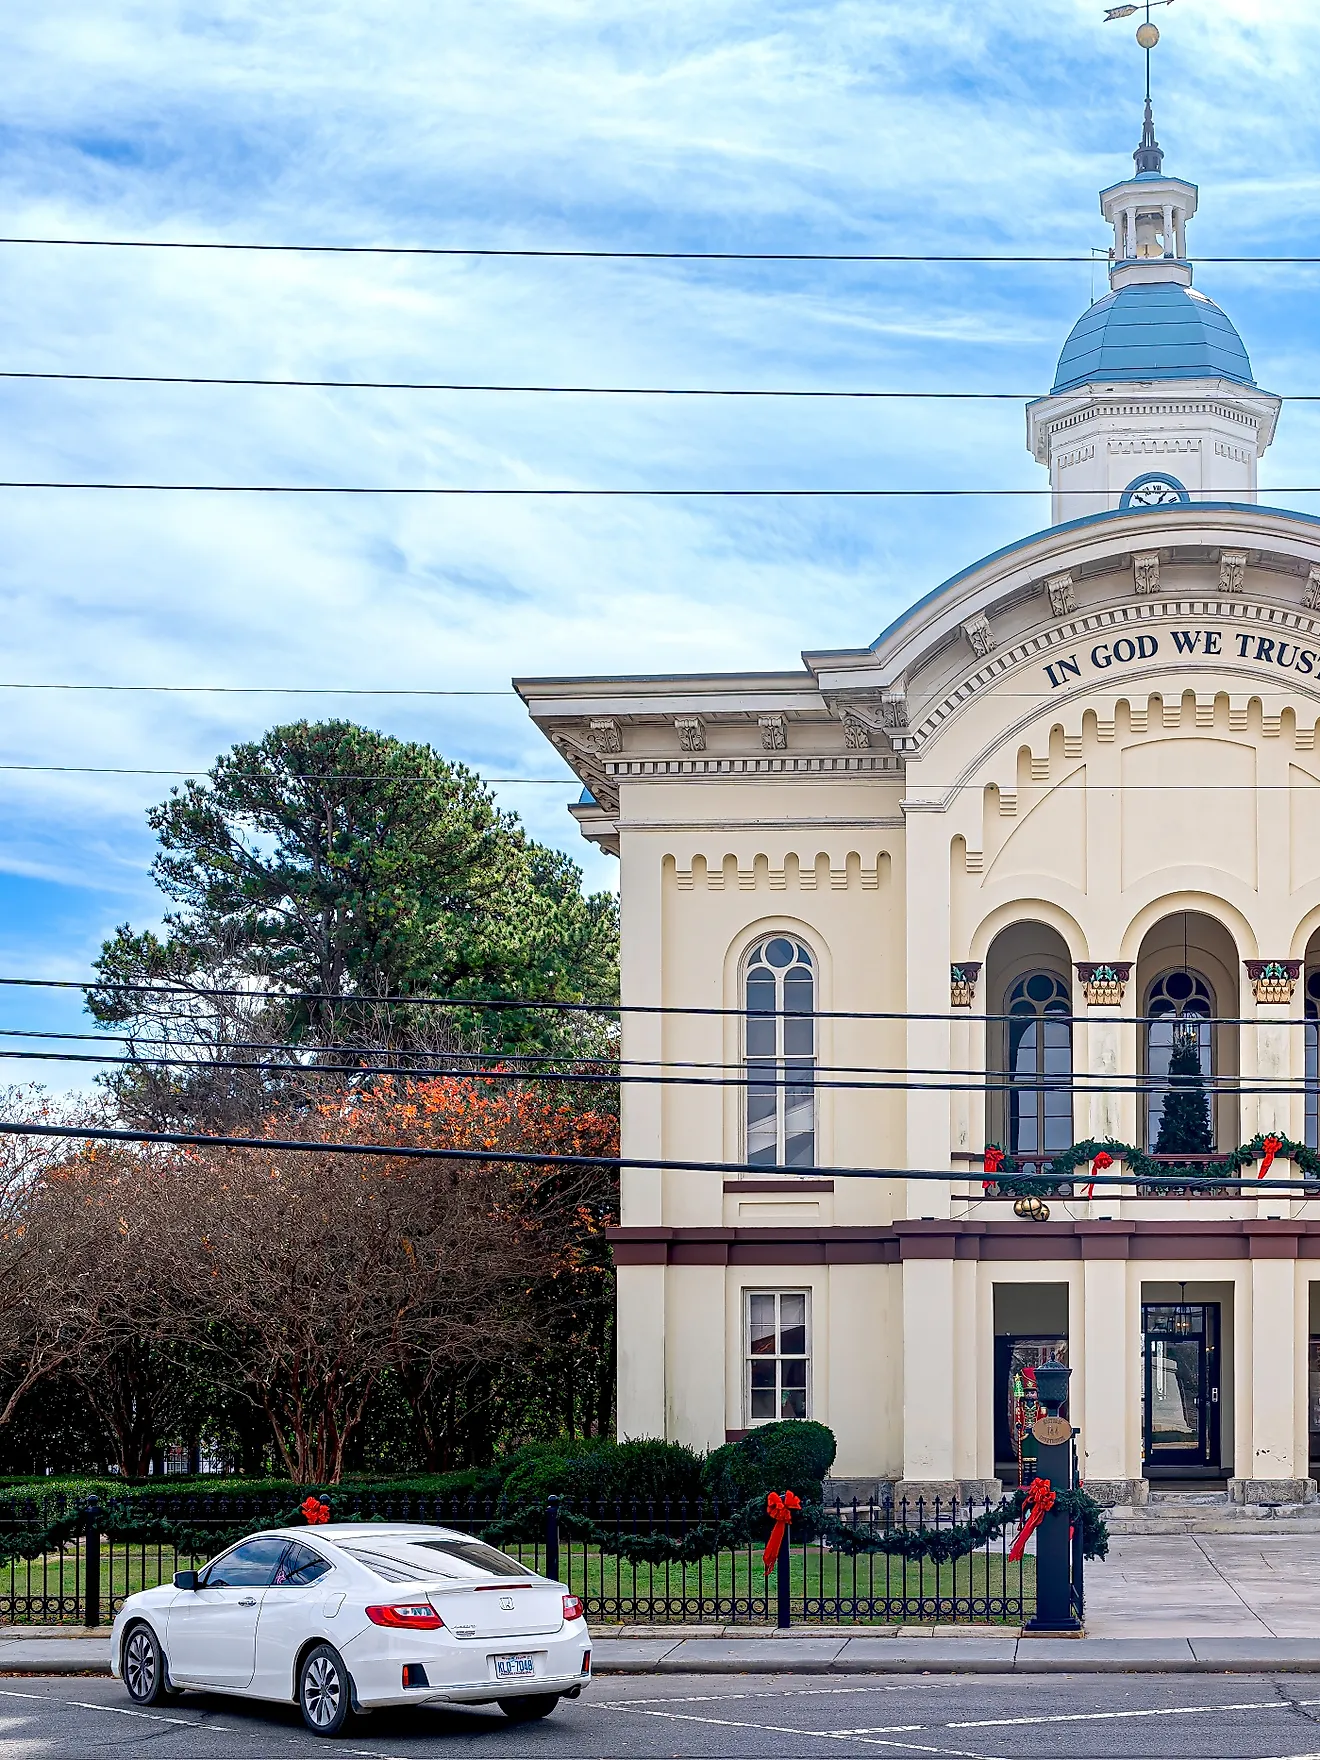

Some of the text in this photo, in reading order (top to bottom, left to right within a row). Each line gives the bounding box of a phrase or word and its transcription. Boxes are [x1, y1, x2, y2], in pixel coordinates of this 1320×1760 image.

[1043, 655, 1081, 689] IN
[1091, 634, 1159, 668] GOD
[1170, 631, 1222, 655] WE
